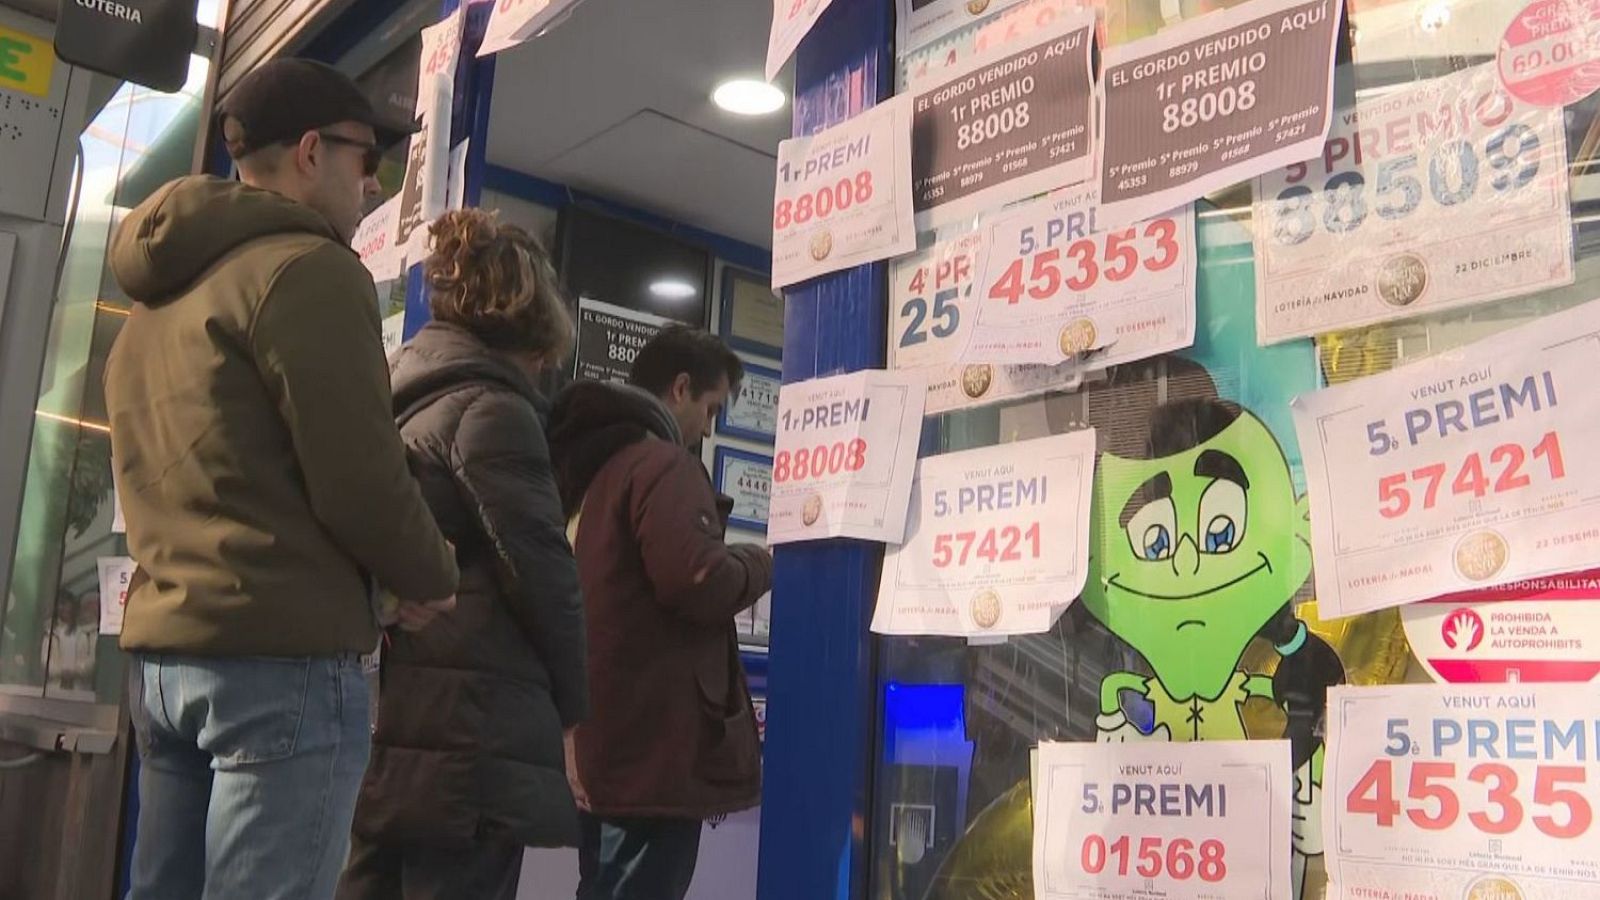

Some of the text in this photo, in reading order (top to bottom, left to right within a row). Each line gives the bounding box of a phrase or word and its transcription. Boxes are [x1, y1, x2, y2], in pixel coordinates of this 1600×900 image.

[1112, 4, 1328, 88] EL GORDO VENDIDO AQUÍ
[918, 31, 1083, 113] EL GORDO VENDIDO AQUÍ
[1156, 52, 1266, 101] 1r PREMIO
[950, 76, 1035, 123] 1r PREMIO
[1162, 80, 1257, 133] 88008
[957, 101, 1031, 150] 88008
[1006, 141, 1038, 158] Premio
[1052, 125, 1085, 142] Premio
[1121, 157, 1157, 176] Premio
[1172, 142, 1209, 162] Premio
[1226, 126, 1263, 146] Premio
[1280, 105, 1319, 125] Premio
[1324, 90, 1514, 174] PREMIO
[779, 161, 801, 183] 1r
[804, 135, 872, 181] PREMI
[1049, 141, 1076, 159] 57421
[1118, 174, 1147, 190] 45353
[1169, 161, 1199, 178] 88979
[1274, 123, 1540, 245] 88509
[774, 170, 873, 231] 88008
[987, 216, 1179, 305] 45353
[1470, 250, 1532, 271] DICIEMBRE
[1323, 284, 1369, 302] NAVIDAD
[584, 312, 594, 322] EL
[595, 314, 624, 329] GORDO
[606, 331, 616, 342] 1r
[899, 283, 973, 349] 25
[608, 344, 640, 364] 880
[1404, 370, 1558, 446] PREMI
[1411, 381, 1455, 400] VENUT
[782, 398, 870, 432] 1r PREMI
[774, 438, 867, 483] 88008
[1378, 430, 1566, 519] 57421
[958, 476, 1047, 514] PREMI
[932, 521, 1040, 568] 57421
[1490, 612, 1552, 622] PROHIBIDA
[1490, 626, 1558, 636] LA VENDA A
[1490, 640, 1582, 649] AUTOPROHIBITS
[1443, 694, 1536, 709] VENUT AQUÍ
[1432, 720, 1600, 761] PREMI
[1119, 766, 1153, 776] VENUT
[1112, 784, 1226, 817] PREMI
[1346, 759, 1593, 839] 4535
[1081, 834, 1227, 882] 01568
